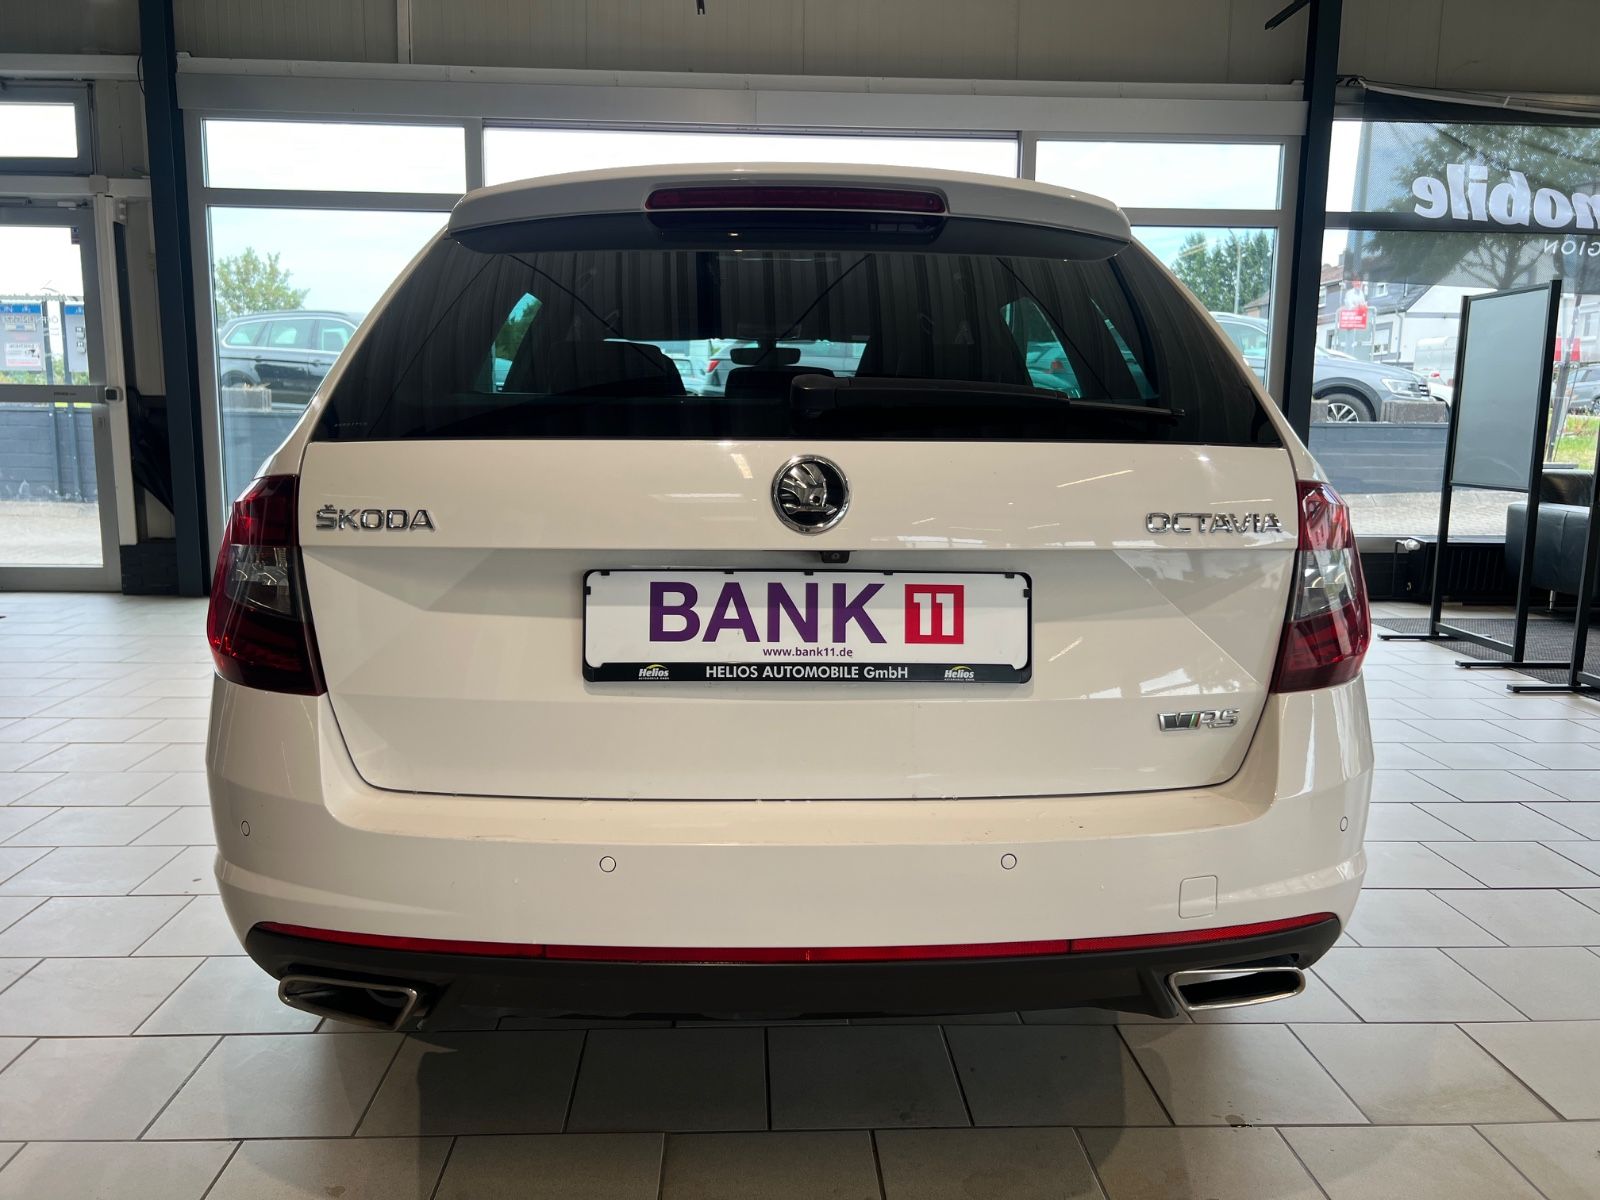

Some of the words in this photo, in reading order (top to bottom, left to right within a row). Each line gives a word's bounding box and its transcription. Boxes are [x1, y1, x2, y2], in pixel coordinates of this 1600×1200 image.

[315, 504, 435, 531] ŠKODA
[1145, 512, 1282, 533] OCTAVIA
[649, 581, 887, 643] BANK
[913, 592, 955, 636] 11
[763, 646, 853, 658] www.bank11.de
[638, 667, 670, 677] Helios
[705, 666, 758, 678] HELIOS
[762, 666, 859, 679] AUTOMOBILE
[863, 666, 909, 679] GmbH
[944, 669, 975, 679] Helios
